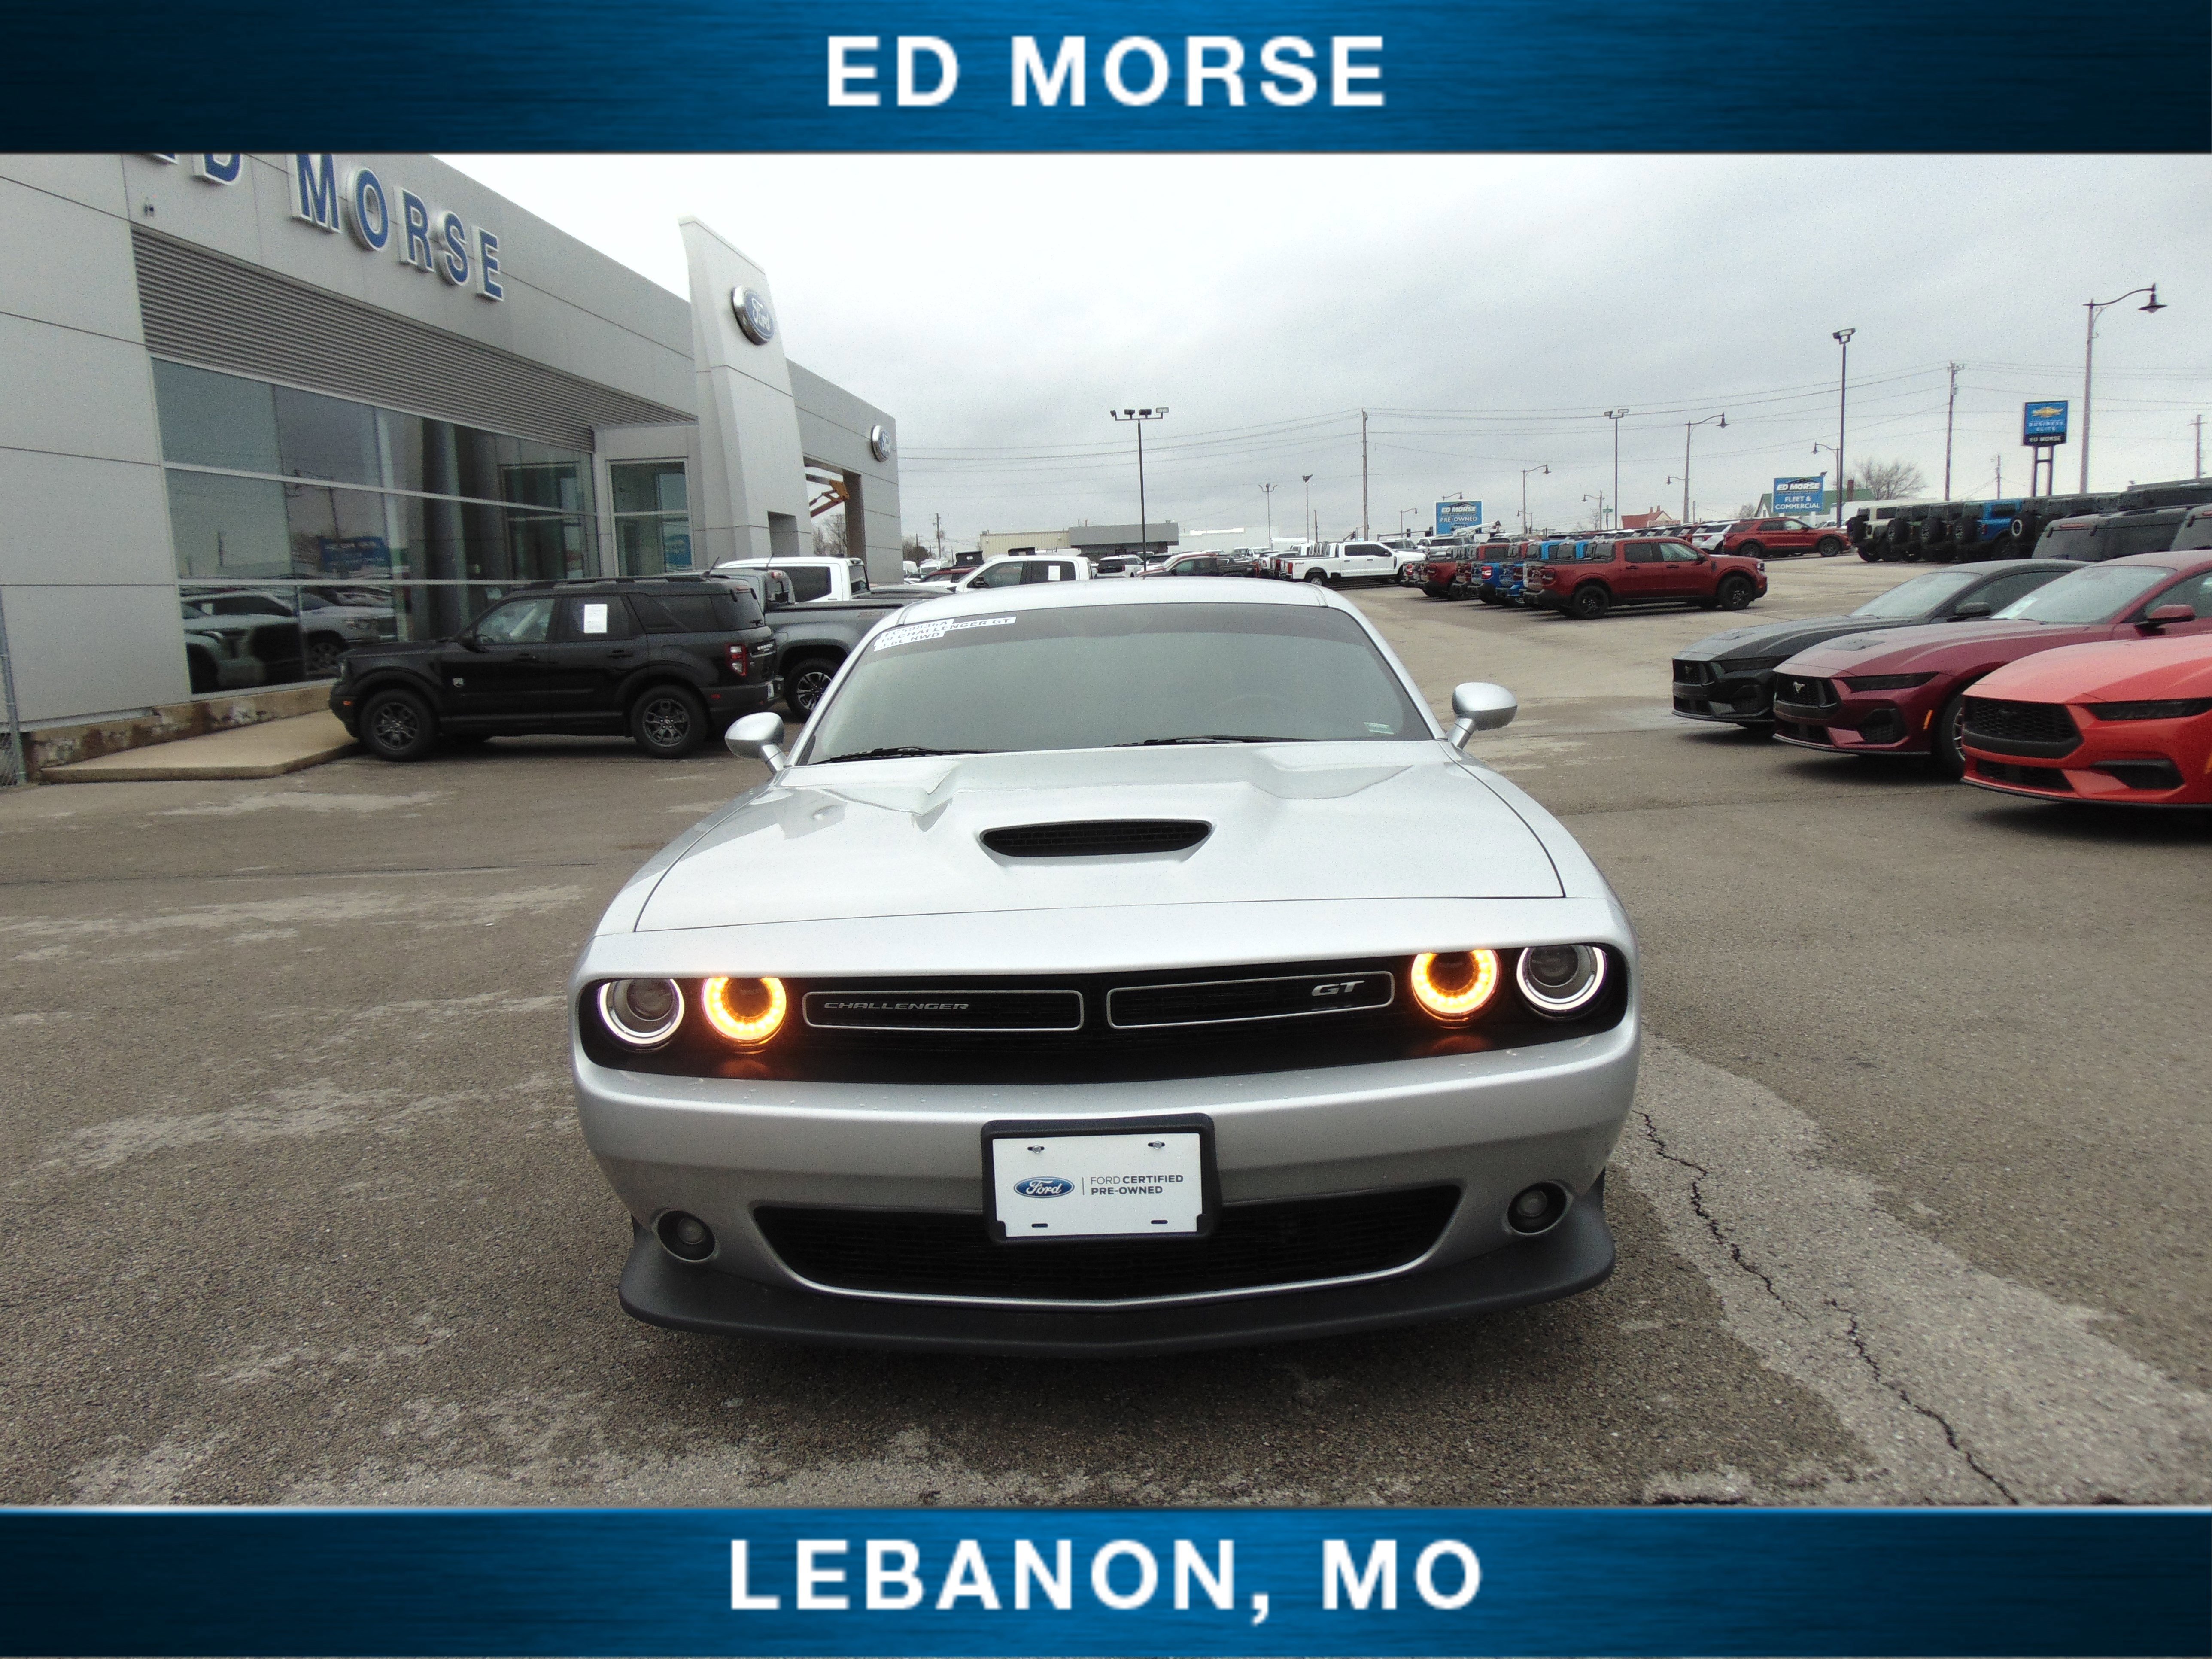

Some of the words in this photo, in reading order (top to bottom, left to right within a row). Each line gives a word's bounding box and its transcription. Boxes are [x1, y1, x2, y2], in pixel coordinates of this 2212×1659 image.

[290, 154, 503, 301] MORSE
[897, 620, 987, 638] CHALLENGER
[910, 632, 940, 641] RWD
[1311, 980, 1365, 997] GT
[1091, 1176, 1121, 1185] FORD
[1122, 1174, 1184, 1184] CERTIFIED
[1026, 1180, 1062, 1194] Ford
[1091, 1185, 1163, 1195] PRE-OWNED
